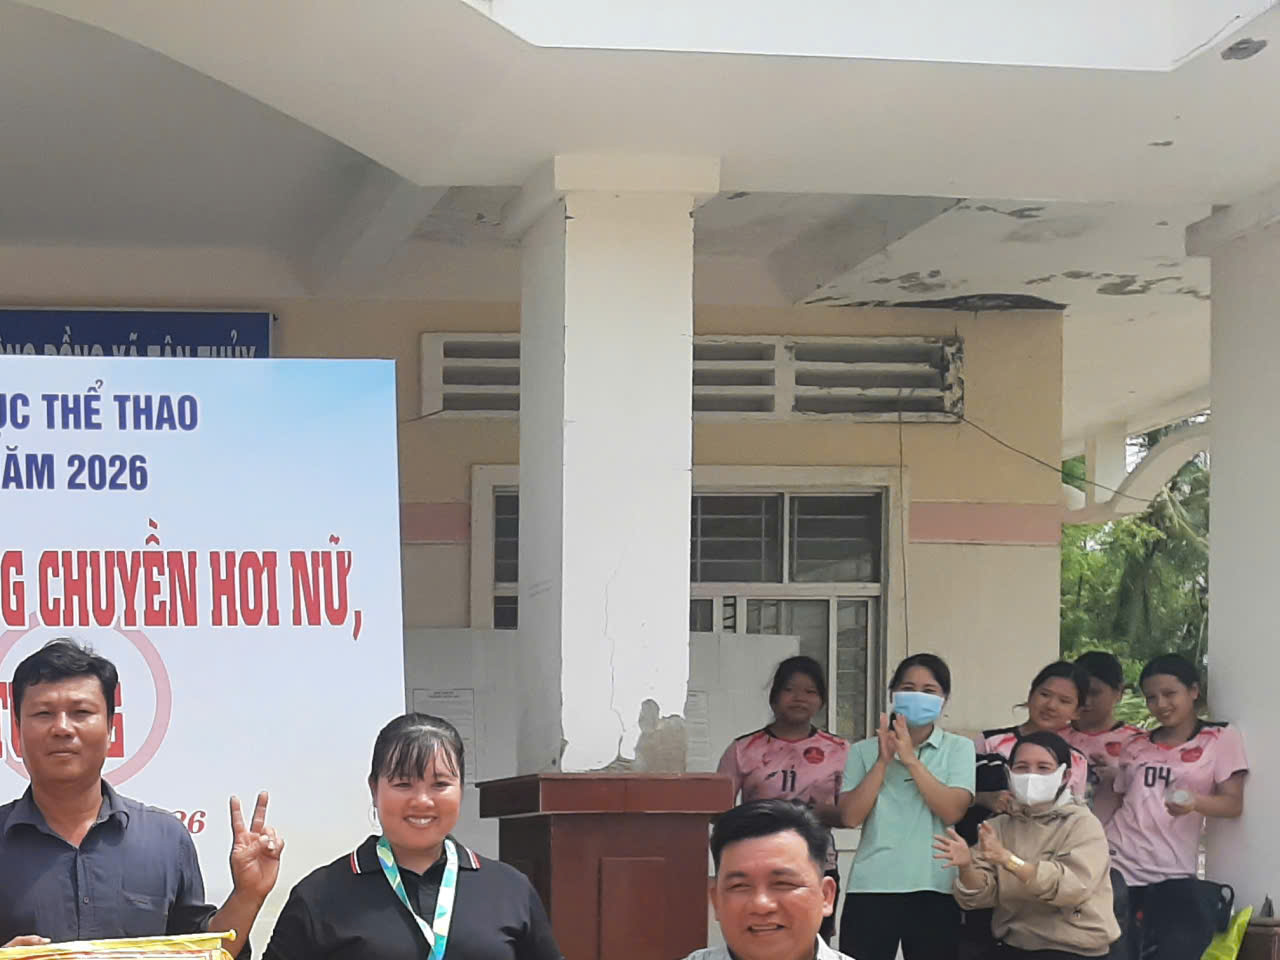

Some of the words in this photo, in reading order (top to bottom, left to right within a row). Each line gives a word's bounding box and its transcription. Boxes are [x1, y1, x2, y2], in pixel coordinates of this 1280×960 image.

[42, 380, 104, 430] THỂ
[113, 394, 198, 431] THAO
[67, 455, 148, 490] 2026
[39, 518, 198, 627] CHUYỀN
[210, 551, 279, 626] HƠI
[291, 533, 363, 640] NỮ,
[1144, 766, 1171, 788] 04
